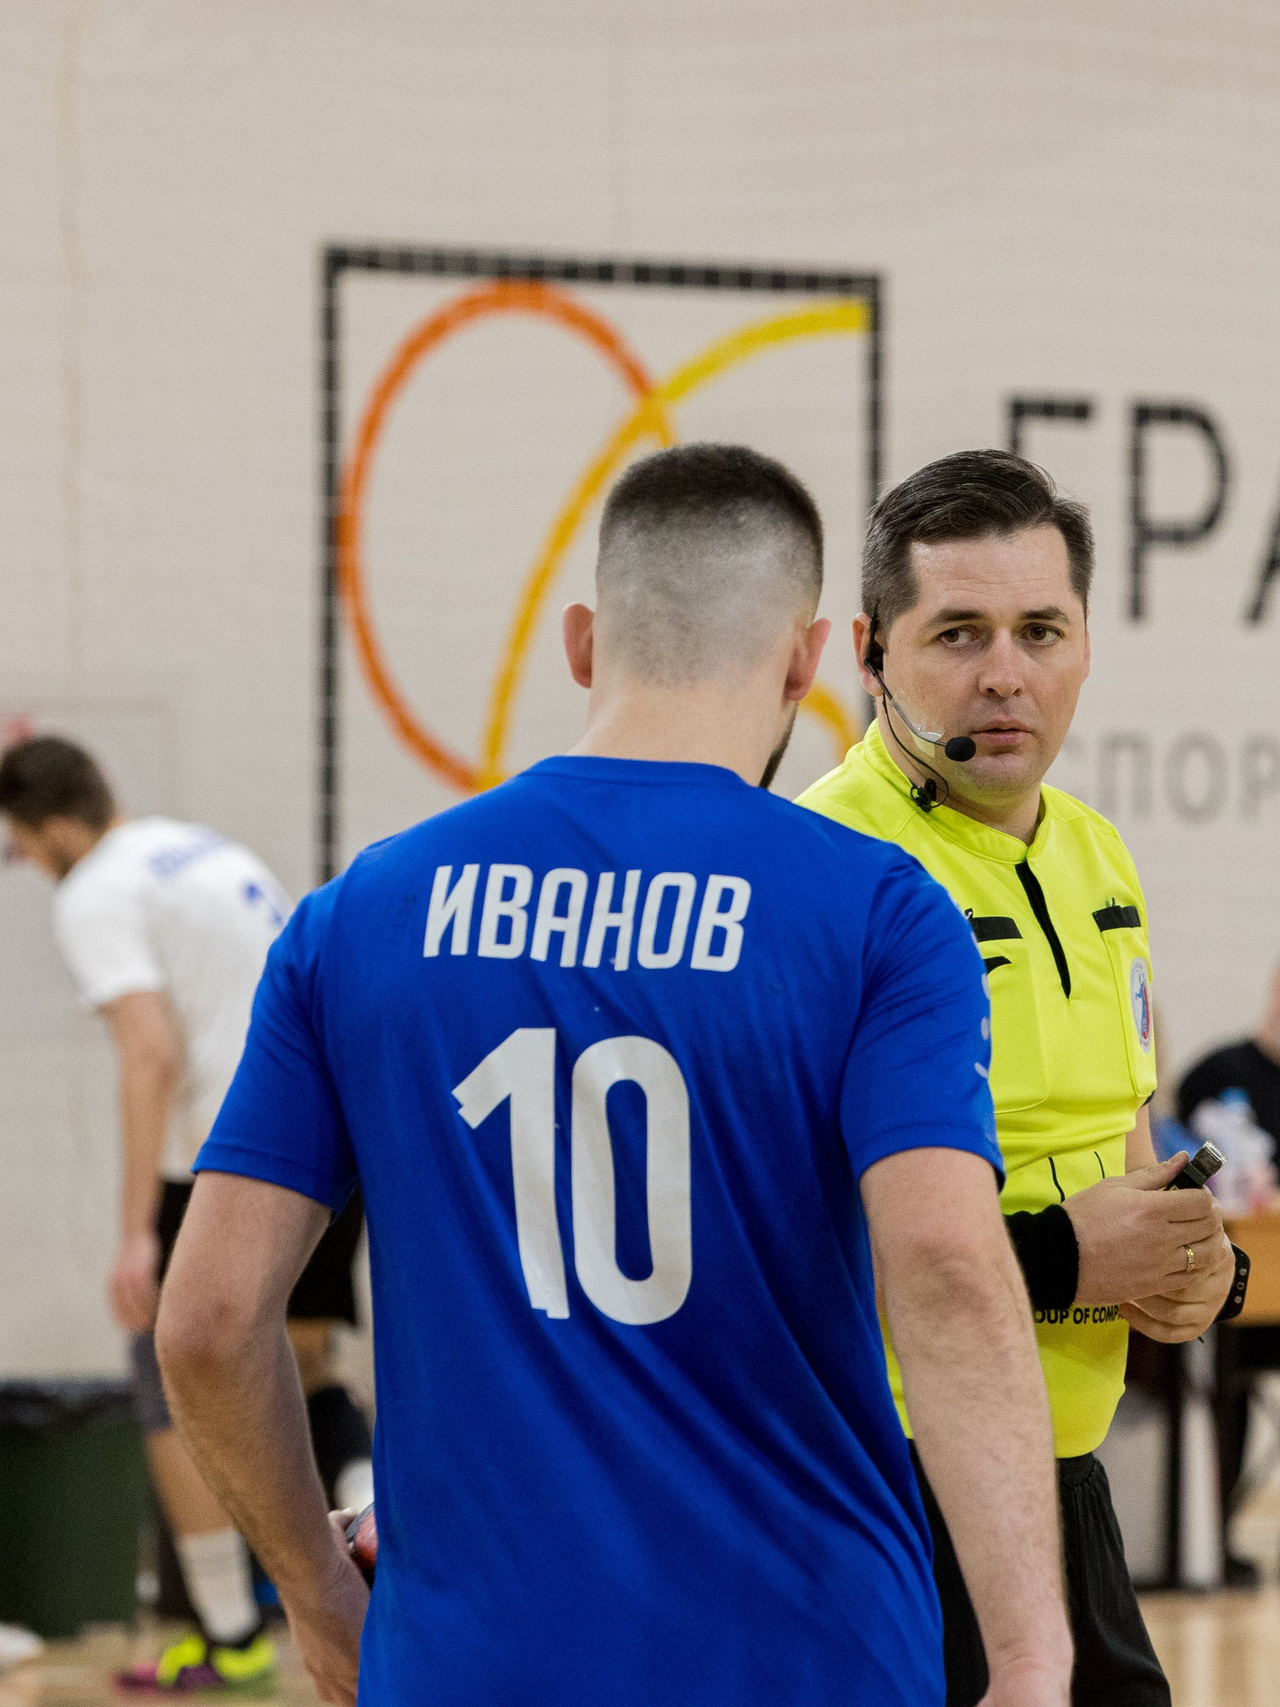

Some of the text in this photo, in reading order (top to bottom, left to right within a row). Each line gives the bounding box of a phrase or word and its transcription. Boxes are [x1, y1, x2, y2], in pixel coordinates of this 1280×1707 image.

[423, 863, 752, 973] ИВАНОВ
[451, 1026, 694, 1327] 10
[1034, 1303, 1121, 1325] OUP OF COMP
